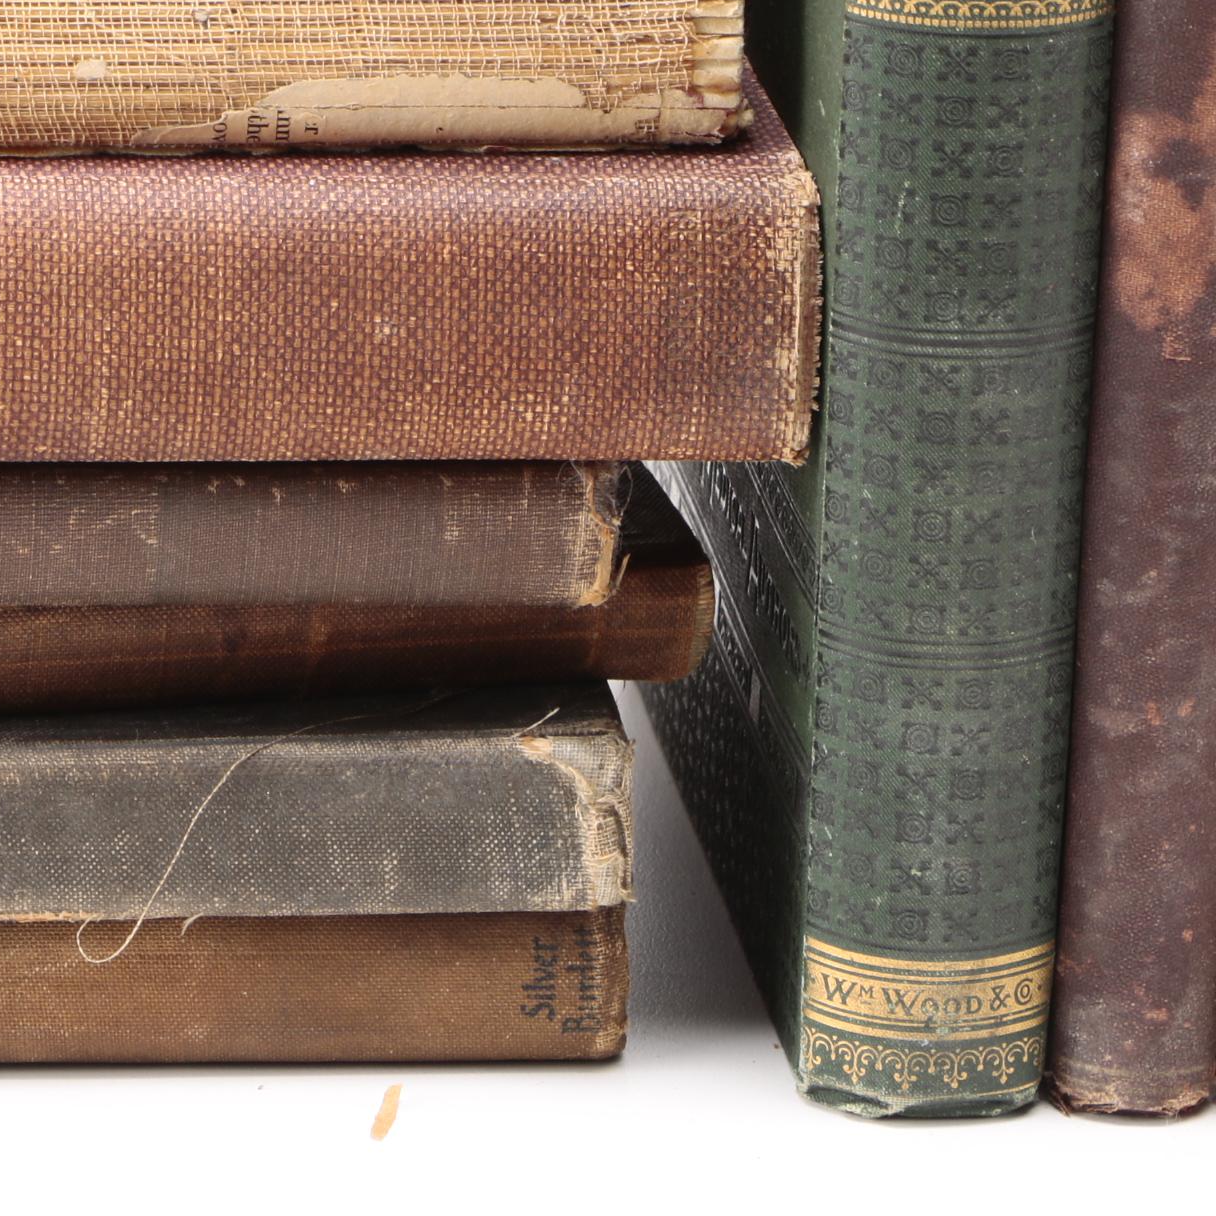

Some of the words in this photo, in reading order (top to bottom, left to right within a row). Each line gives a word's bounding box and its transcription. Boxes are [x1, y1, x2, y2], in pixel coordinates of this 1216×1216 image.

[520, 935, 559, 1022] Silver
[881, 985, 984, 1017] WOOD
[988, 984, 1012, 1012] &
